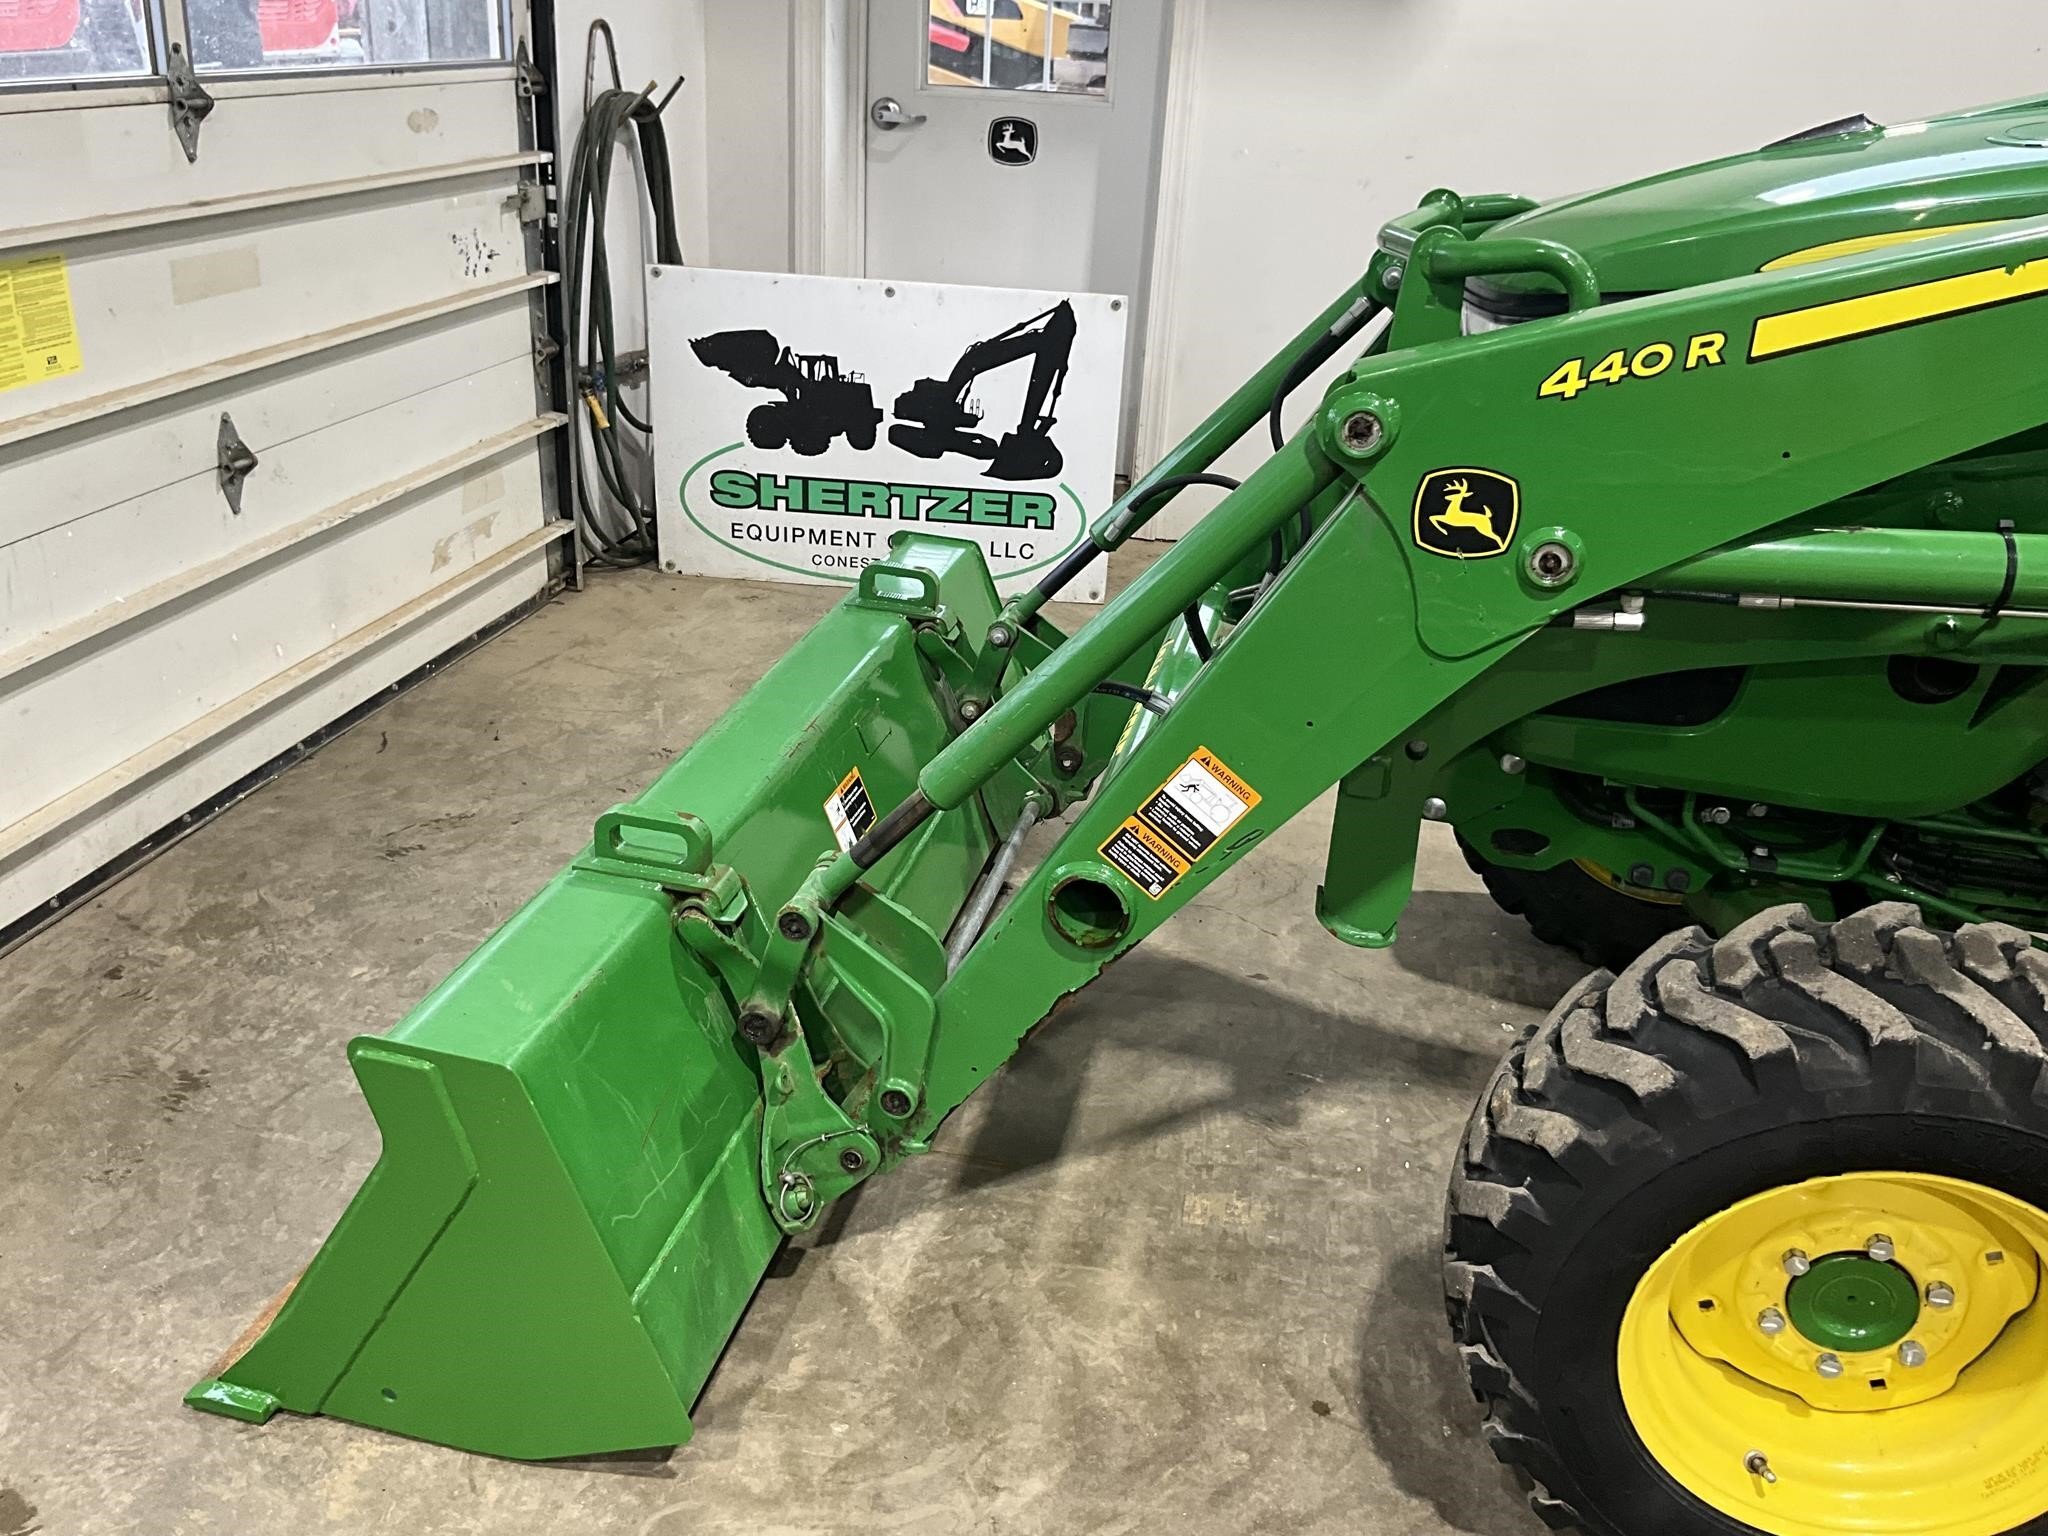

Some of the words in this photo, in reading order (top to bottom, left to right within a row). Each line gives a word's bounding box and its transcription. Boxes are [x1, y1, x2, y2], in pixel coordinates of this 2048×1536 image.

[1537, 341, 1675, 400] 440
[1683, 331, 1727, 371] R
[710, 470, 1056, 530] SHERTZER
[731, 522, 877, 548] EQUIPMENT
[990, 541, 1034, 560] LLC
[1211, 764, 1251, 801] WARNING
[1143, 832, 1181, 868] WARNING
